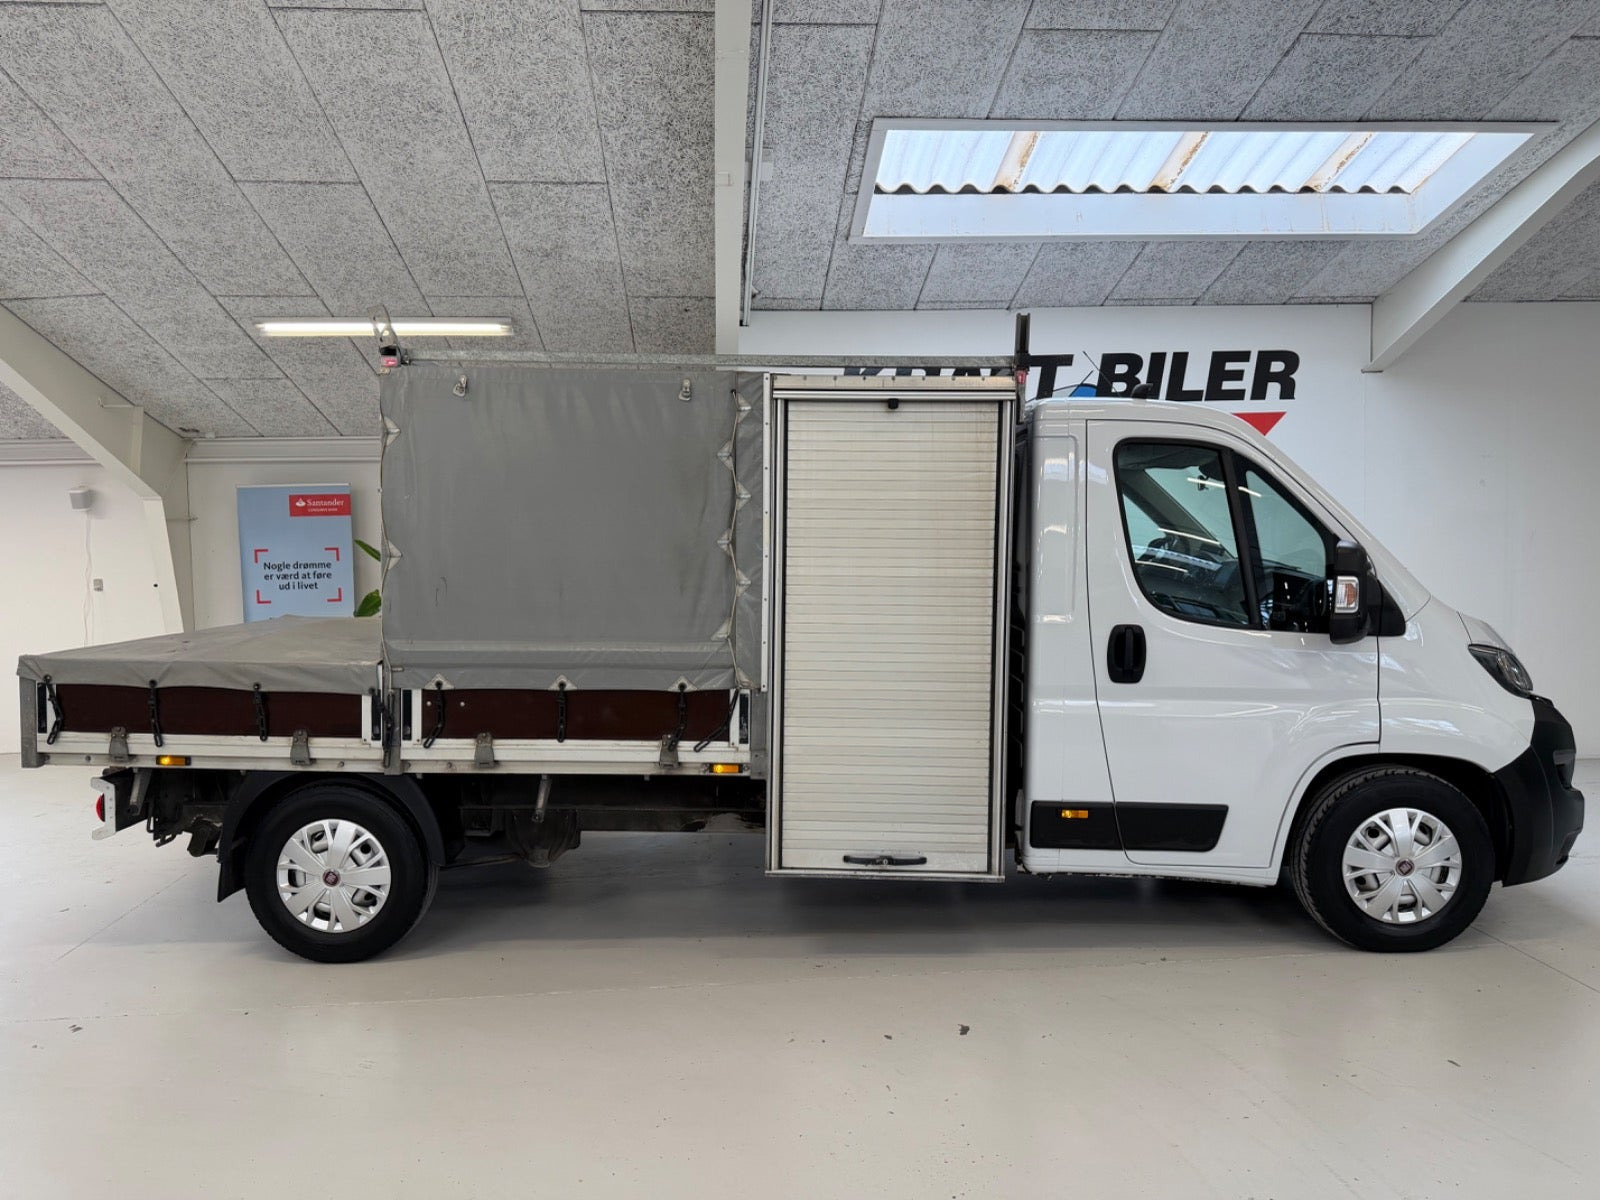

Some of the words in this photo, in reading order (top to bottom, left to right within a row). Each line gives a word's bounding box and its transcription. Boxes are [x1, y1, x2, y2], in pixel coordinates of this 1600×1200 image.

[1096, 350, 1300, 402] BILER
[306, 498, 344, 507] Santander
[263, 561, 291, 571] Nogle
[292, 561, 332, 570] drømme
[276, 571, 299, 580] værd
[301, 571, 311, 579] at
[313, 571, 332, 579] føre
[279, 582, 290, 590] ud
[298, 581, 318, 590] livet
